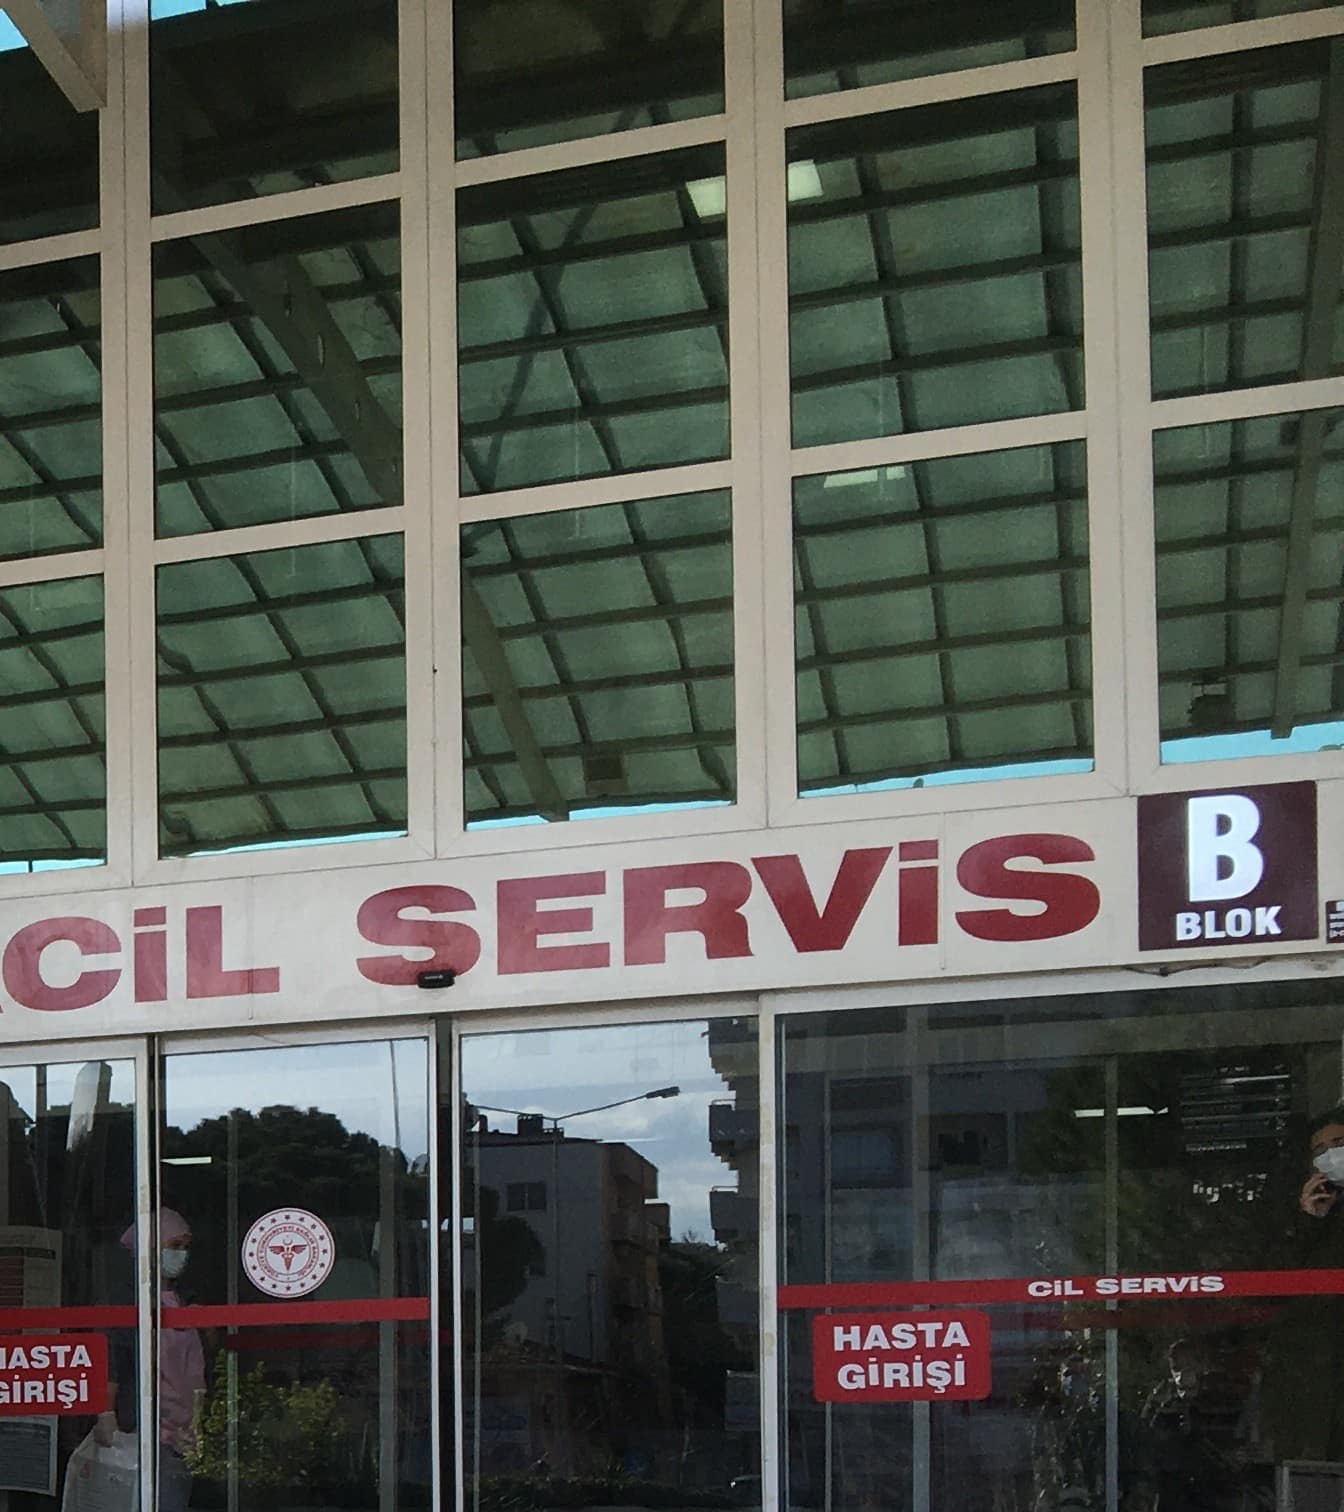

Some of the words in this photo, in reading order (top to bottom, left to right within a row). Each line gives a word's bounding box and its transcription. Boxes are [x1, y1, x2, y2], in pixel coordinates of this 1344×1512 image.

[1188, 794, 1264, 902] B
[1176, 905, 1282, 941] BLOK
[833, 1321, 971, 1352] HASTA
